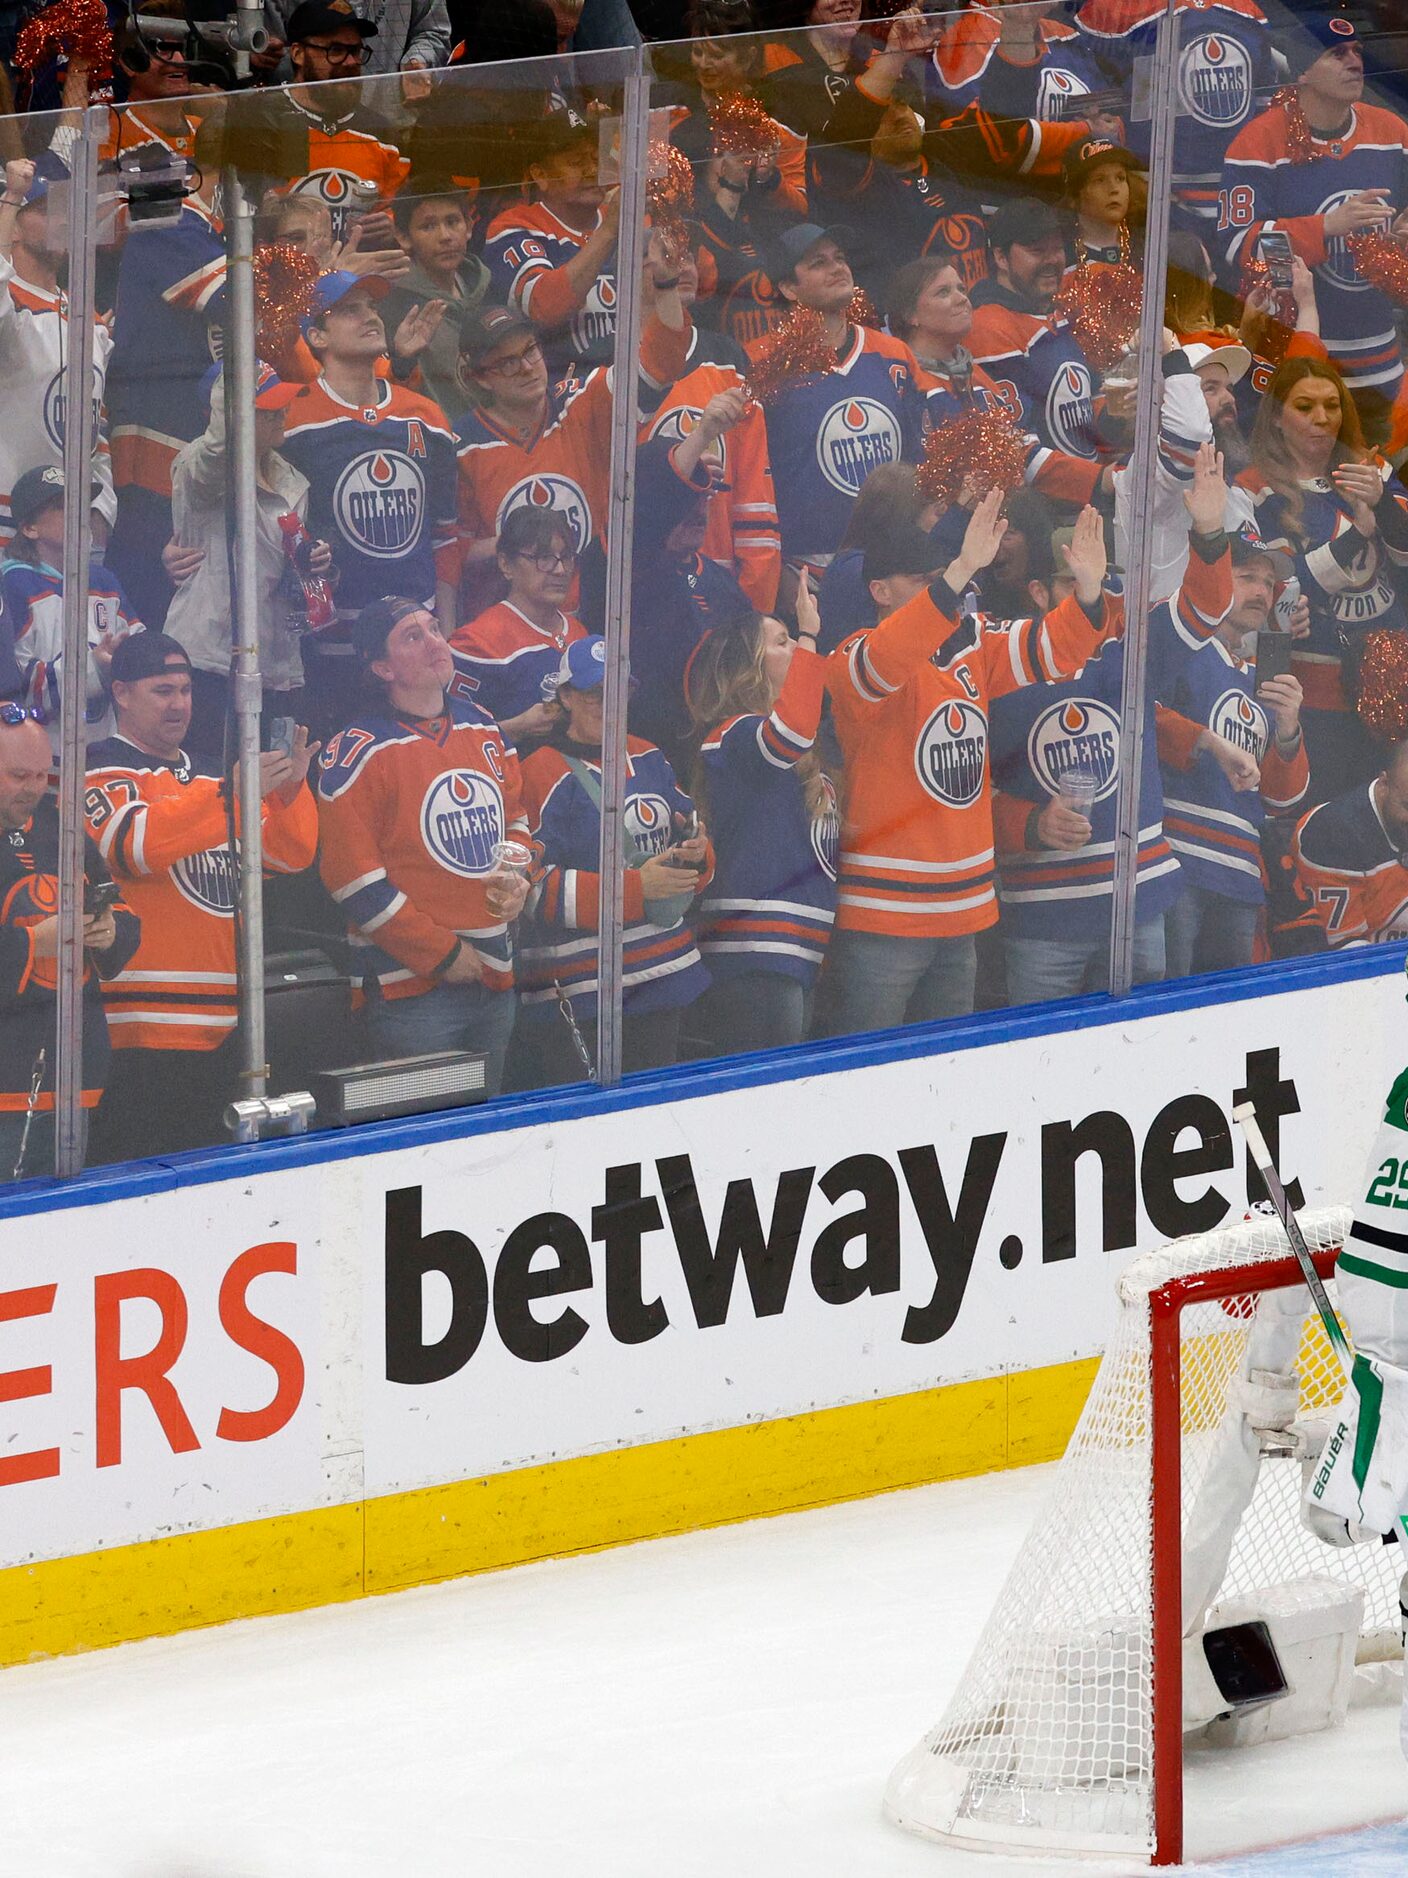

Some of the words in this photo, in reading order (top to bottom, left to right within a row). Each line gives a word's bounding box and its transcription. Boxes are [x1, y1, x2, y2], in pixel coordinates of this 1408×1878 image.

[1217, 185, 1255, 231] 18
[409, 422, 427, 458] A
[830, 430, 893, 468] OILERS
[349, 487, 418, 520] OILERS
[95, 601, 107, 632] C
[954, 663, 980, 700] C
[324, 727, 376, 767] 97
[482, 741, 504, 782] C
[930, 735, 985, 771] OILERS
[1044, 732, 1115, 772] OILERS
[85, 778, 138, 828] 97
[436, 804, 498, 843] OILERS
[386, 1046, 1307, 1386] betway.net
